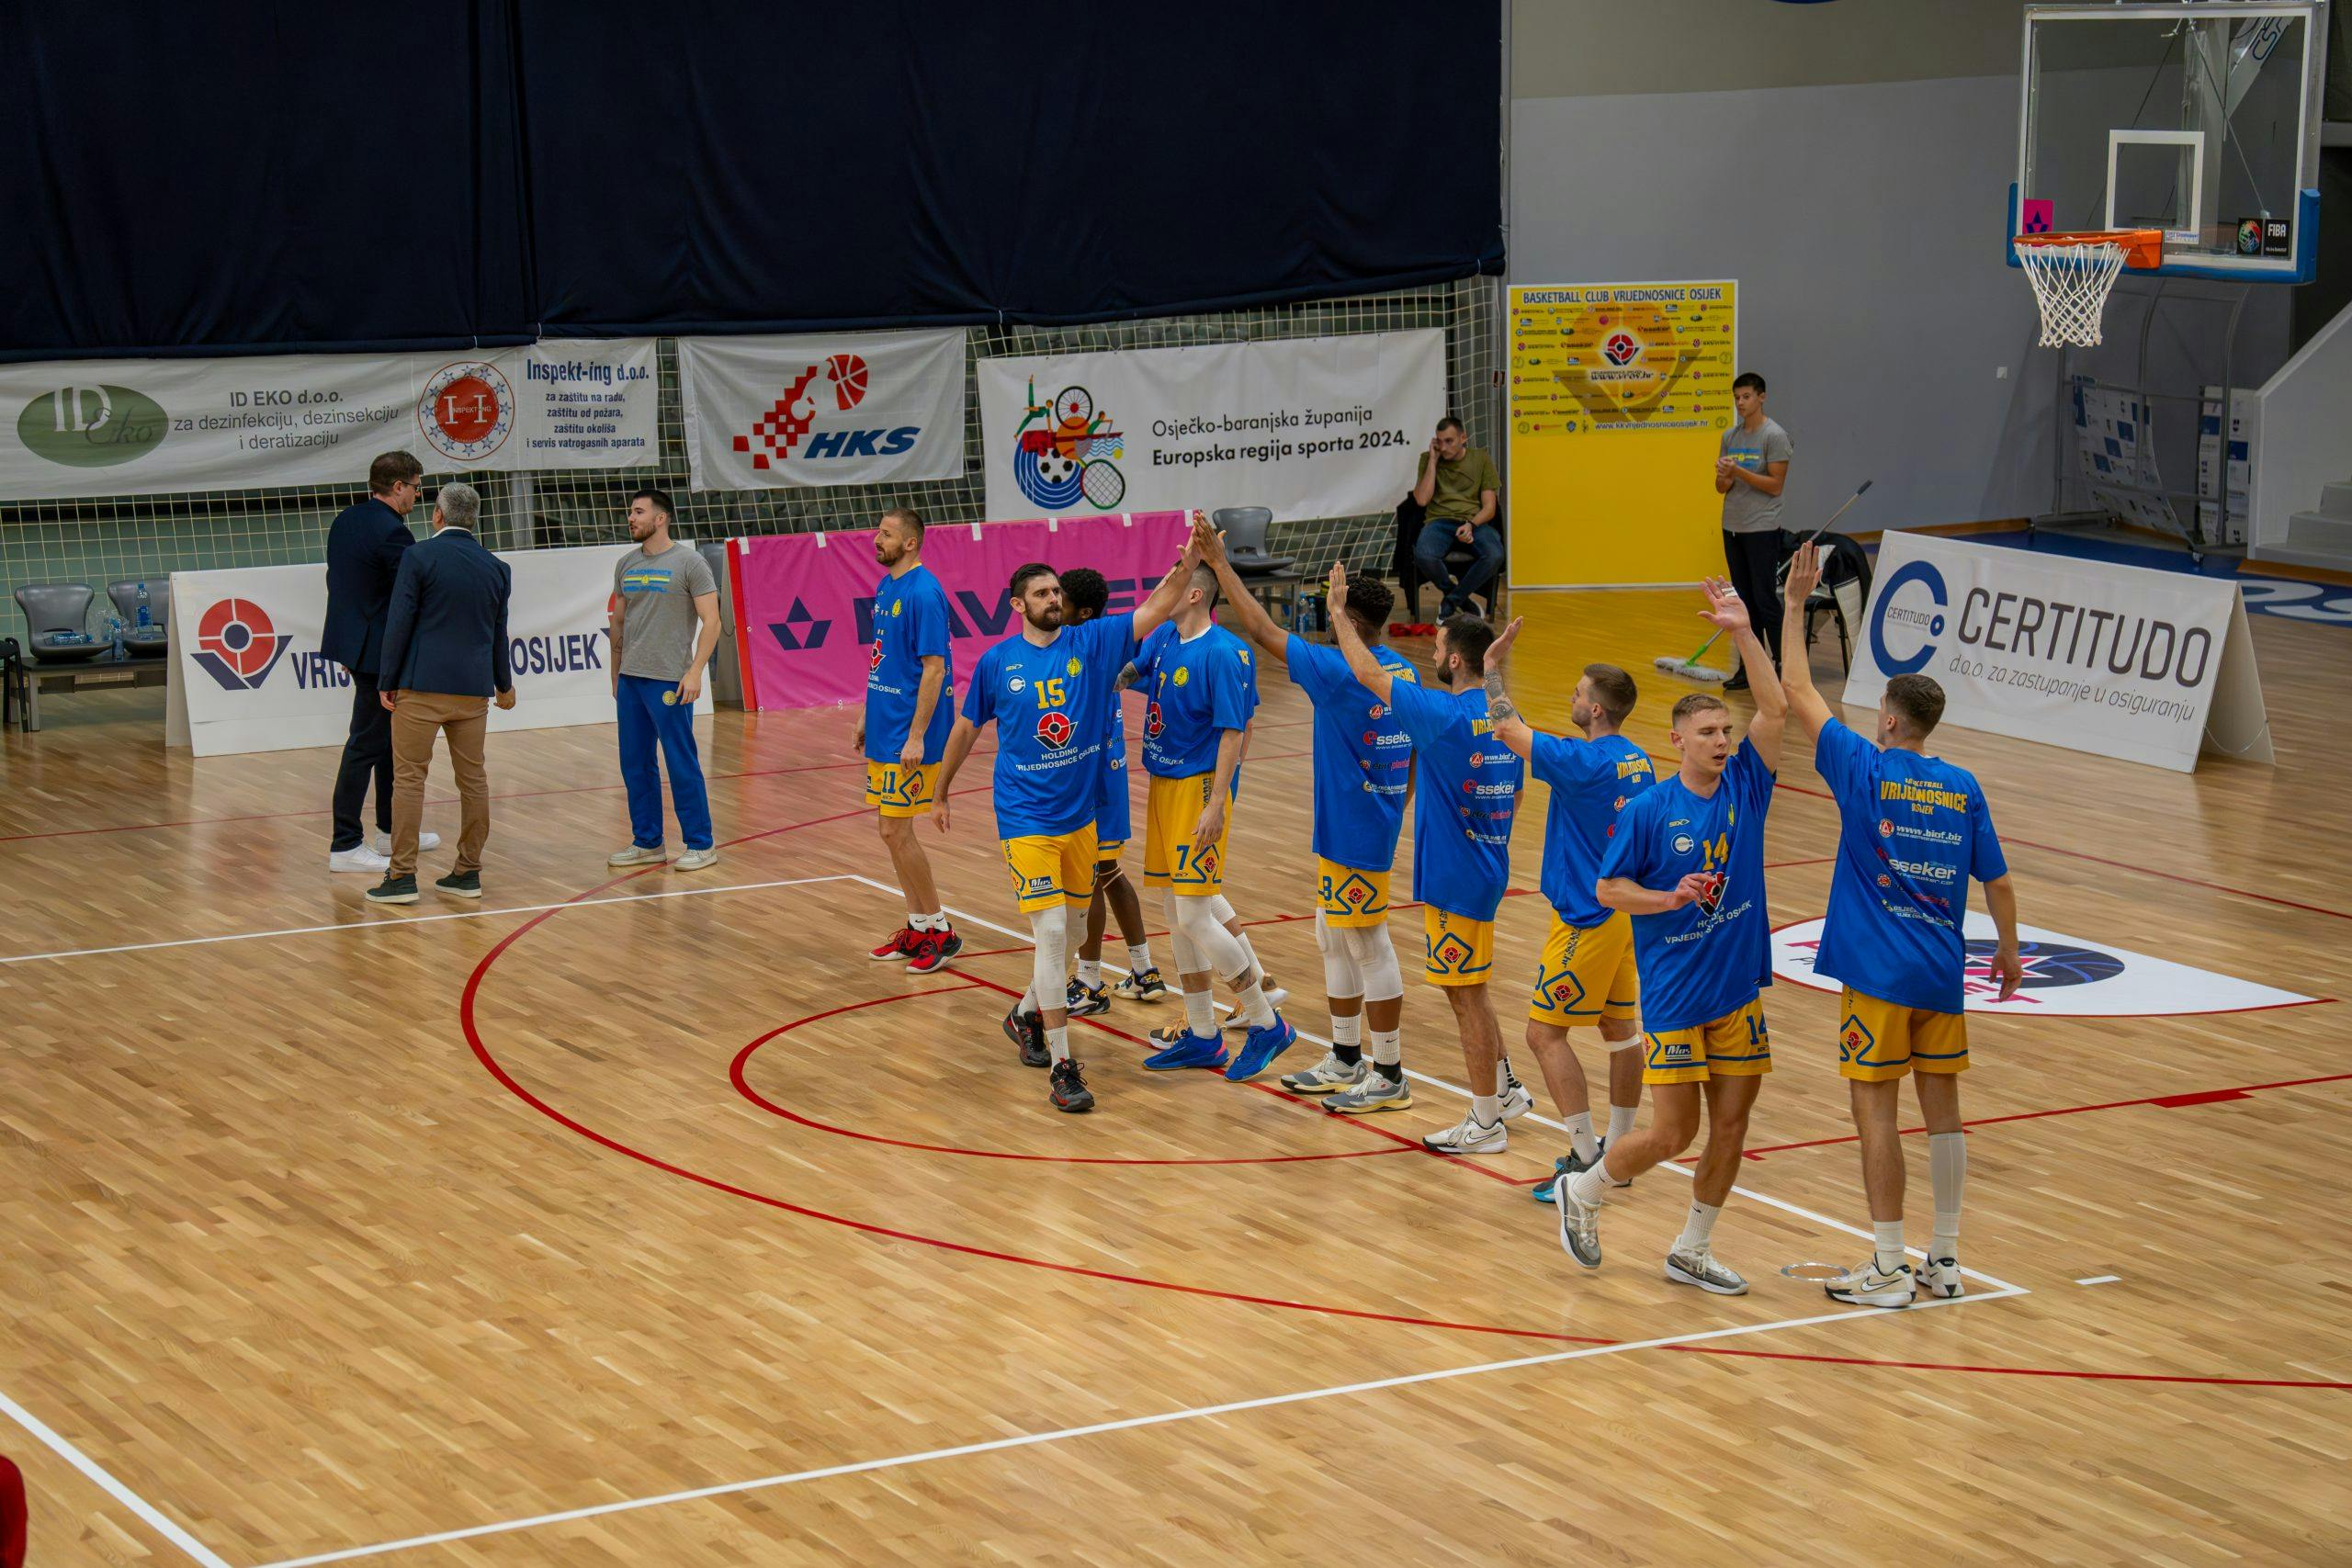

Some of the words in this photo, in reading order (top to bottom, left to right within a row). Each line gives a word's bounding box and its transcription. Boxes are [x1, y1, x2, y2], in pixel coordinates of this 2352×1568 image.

[2267, 223, 2287, 237] FIBA
[1523, 291, 1581, 303] BASKETBALL
[1585, 290, 1609, 301] CLUB
[1613, 288, 1685, 301] VRIJEDNOSNICE
[1690, 288, 1722, 300] OSIJEK
[526, 358, 612, 386] Inspekt-ing
[616, 364, 650, 380] d.o.o.
[230, 391, 248, 407] ID
[254, 390, 292, 406] EKO
[298, 389, 344, 404] d.o.o.
[546, 393, 556, 401] za
[559, 392, 588, 402] zaštitu
[605, 392, 626, 402] radu,
[175, 421, 193, 431] za
[198, 412, 298, 431] dezinfekciju,
[303, 406, 398, 426] dezinsekciju
[547, 408, 578, 418] zaštitu
[581, 408, 591, 418] od
[594, 409, 624, 420] požara,
[1152, 411, 1299, 441] Osječko-baranjska
[1305, 406, 1373, 429] županija
[554, 423, 584, 434] zaštitu
[586, 423, 616, 434] okoliša
[239, 435, 244, 450] i
[248, 433, 339, 450] deratizaciju
[526, 438, 529, 448] i
[532, 437, 556, 448] servis
[559, 438, 608, 450] vatrogasnih
[611, 436, 645, 449] aparata
[804, 426, 922, 459] HKS
[1152, 445, 1236, 468] Europska
[1239, 439, 1293, 462] regija
[1297, 436, 1354, 459] sporta
[1359, 429, 1411, 450] 2024.
[1885, 604, 1930, 626] CERTITUDO
[1958, 588, 2212, 689] CERTITUDO
[510, 633, 603, 676] OSIJEK
[1034, 677, 1066, 710] 15
[1949, 654, 1984, 678] d.o.o.
[1987, 665, 2007, 682] za
[2008, 669, 2092, 703] zastupanje
[2094, 685, 2107, 702] u
[2109, 689, 2197, 724] osiguranju
[1041, 746, 1079, 761] HOLDING
[882, 772, 896, 794] 11
[1881, 780, 1967, 814] VRIJEDNOSNICE
[1176, 845, 1190, 871] 7
[1702, 832, 1729, 871] 14
